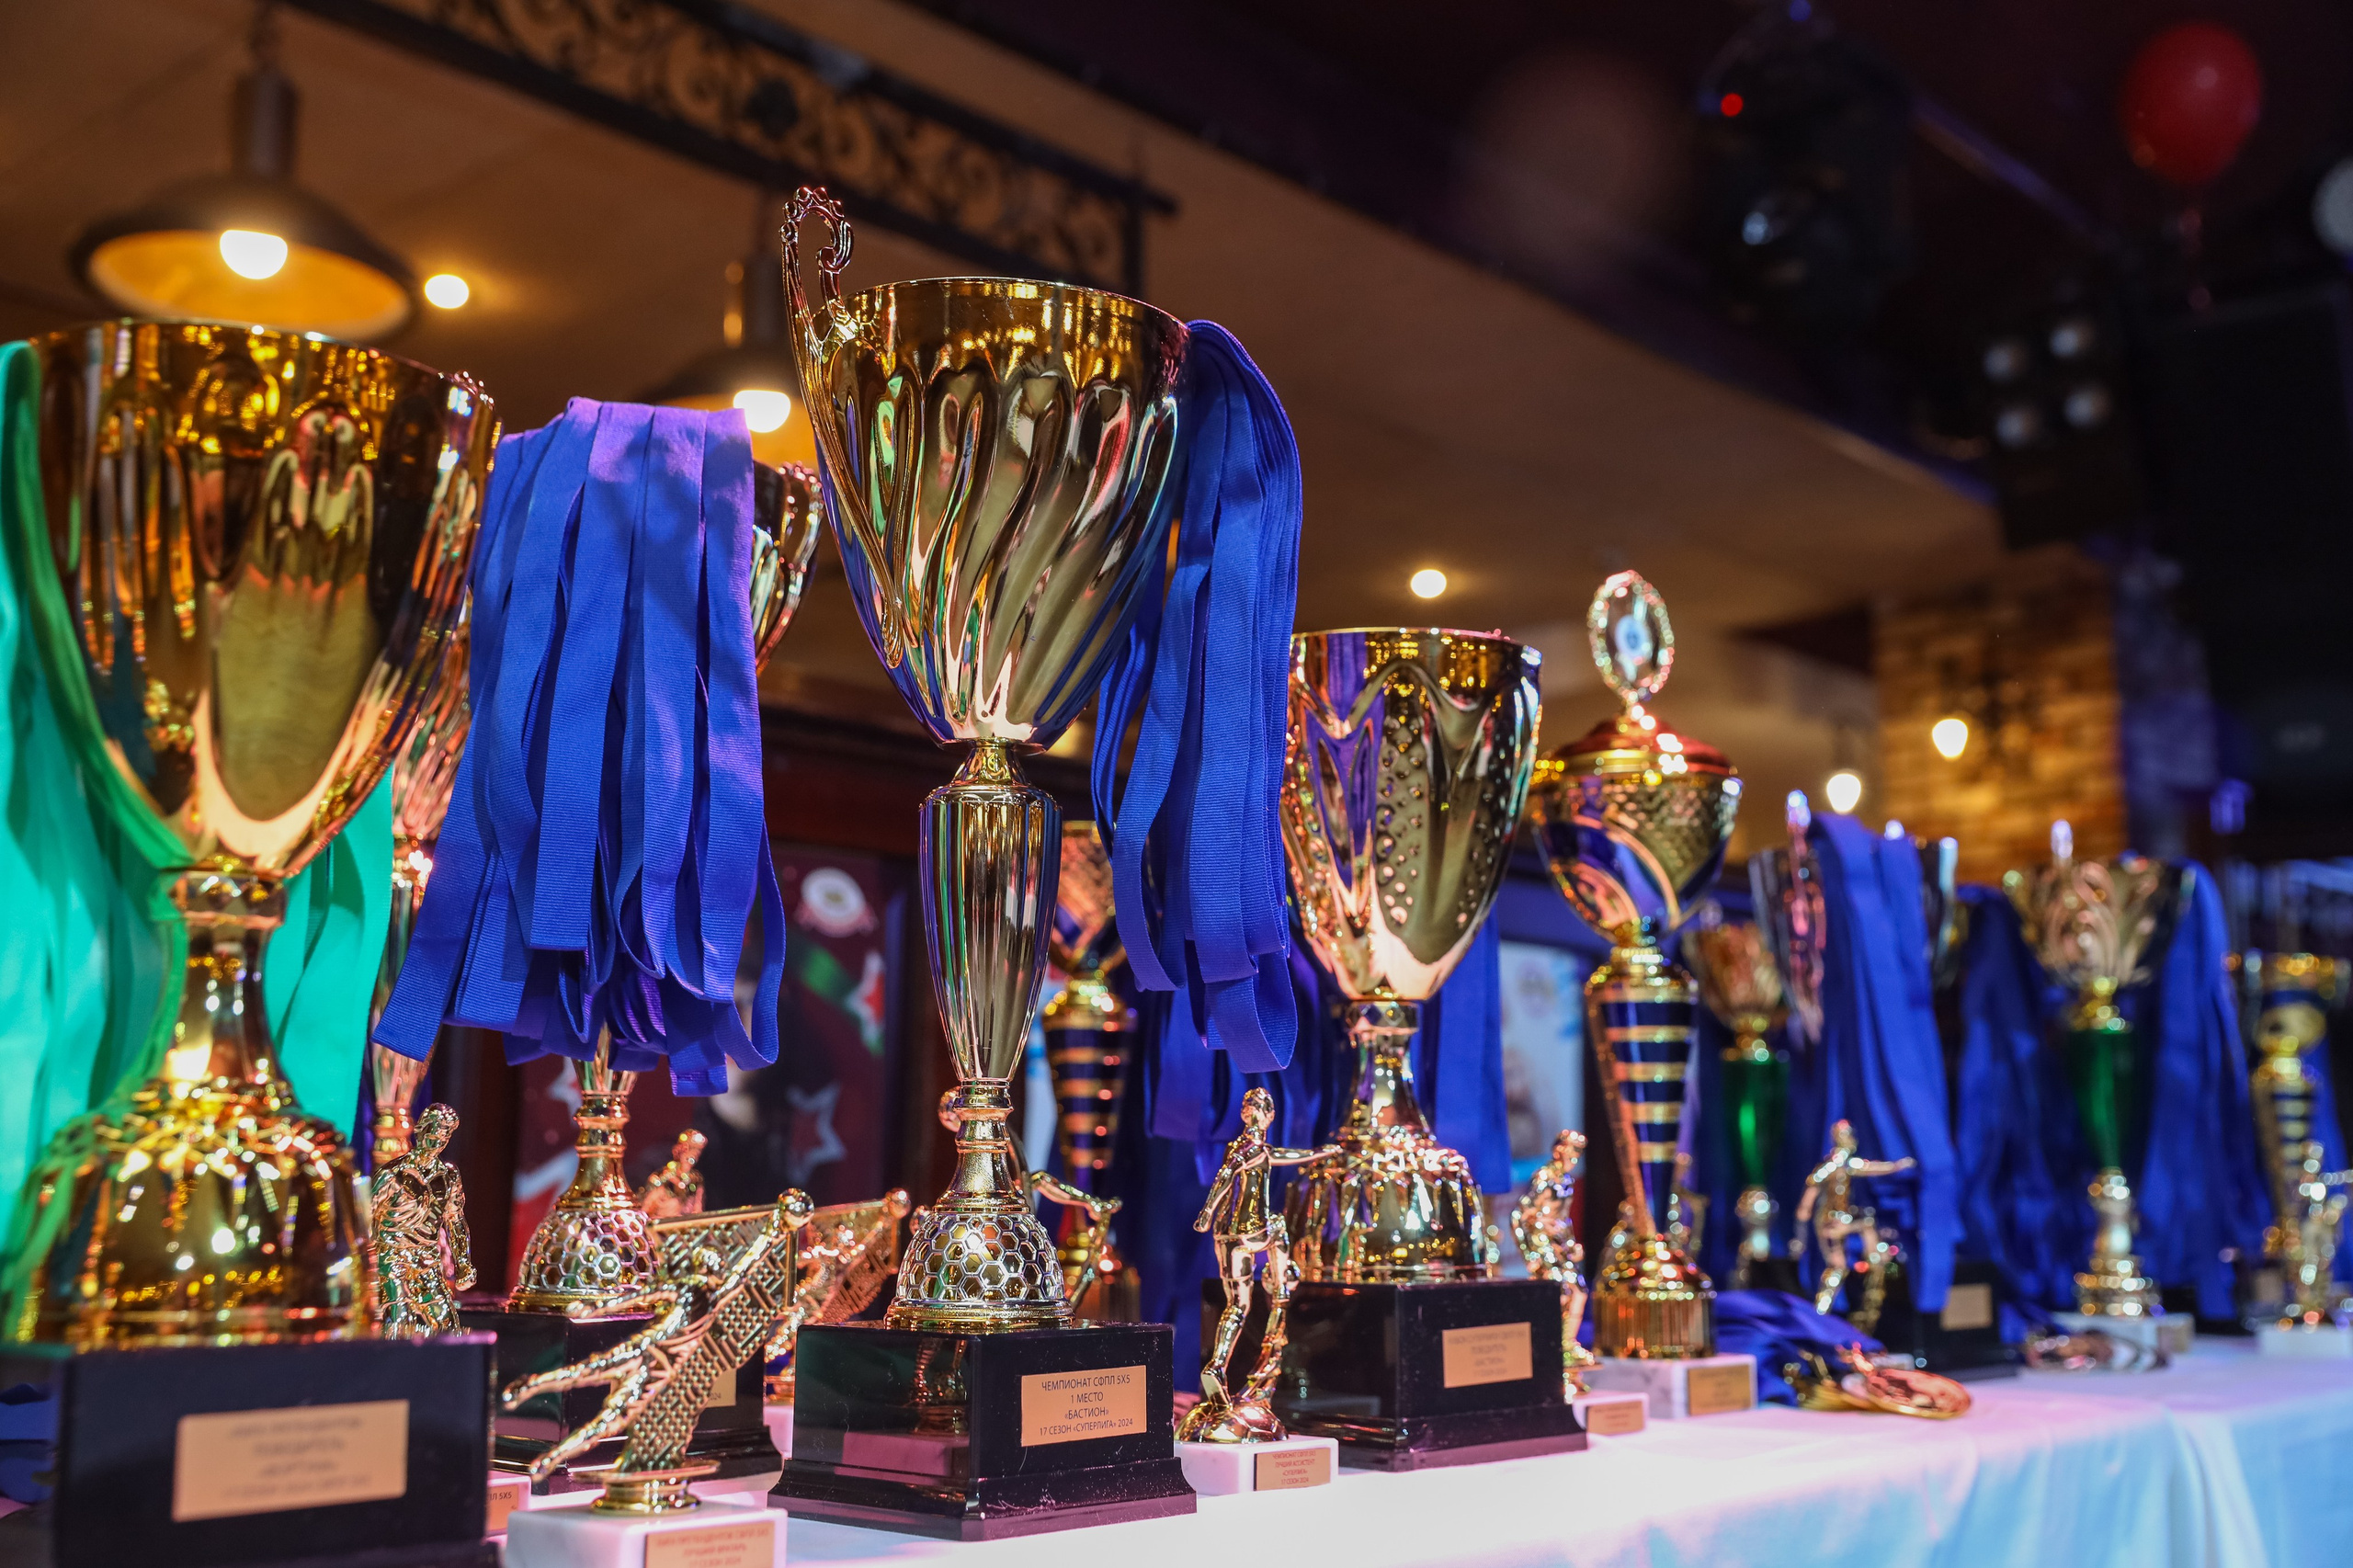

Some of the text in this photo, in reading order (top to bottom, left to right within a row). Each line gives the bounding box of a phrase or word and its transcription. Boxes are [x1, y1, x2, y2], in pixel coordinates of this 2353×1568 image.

[1041, 1378, 1092, 1392] ЧЕМПИОНАТ
[1093, 1375, 1116, 1387] СФПЛ
[1071, 1392, 1104, 1403] 1 МЕСТО
[1064, 1407, 1109, 1420] «БАСТИОН»
[1040, 1418, 1133, 1436] 17 СЕЗОН «СУПЕРЛИГА» 2024
